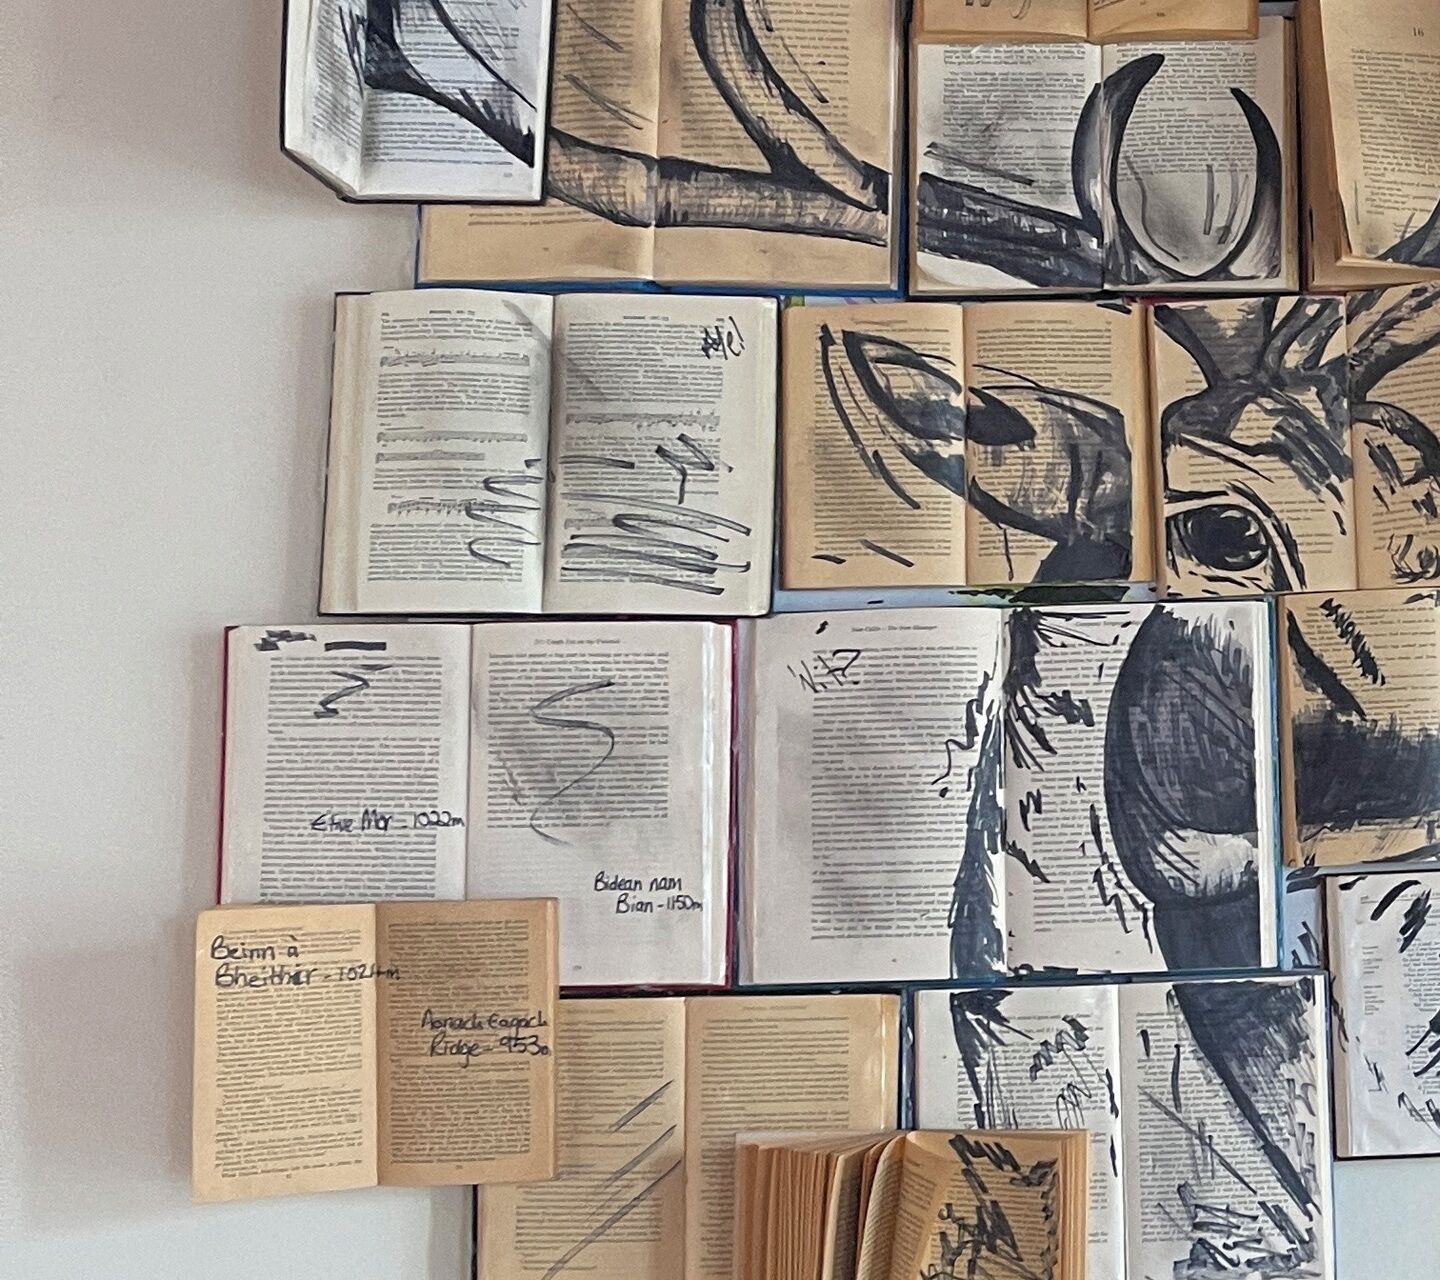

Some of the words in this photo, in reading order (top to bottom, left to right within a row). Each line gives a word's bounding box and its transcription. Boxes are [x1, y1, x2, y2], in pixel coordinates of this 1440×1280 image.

[594, 871, 642, 891] Bidean
[649, 876, 682, 892] nam
[616, 892, 653, 913] Bian
